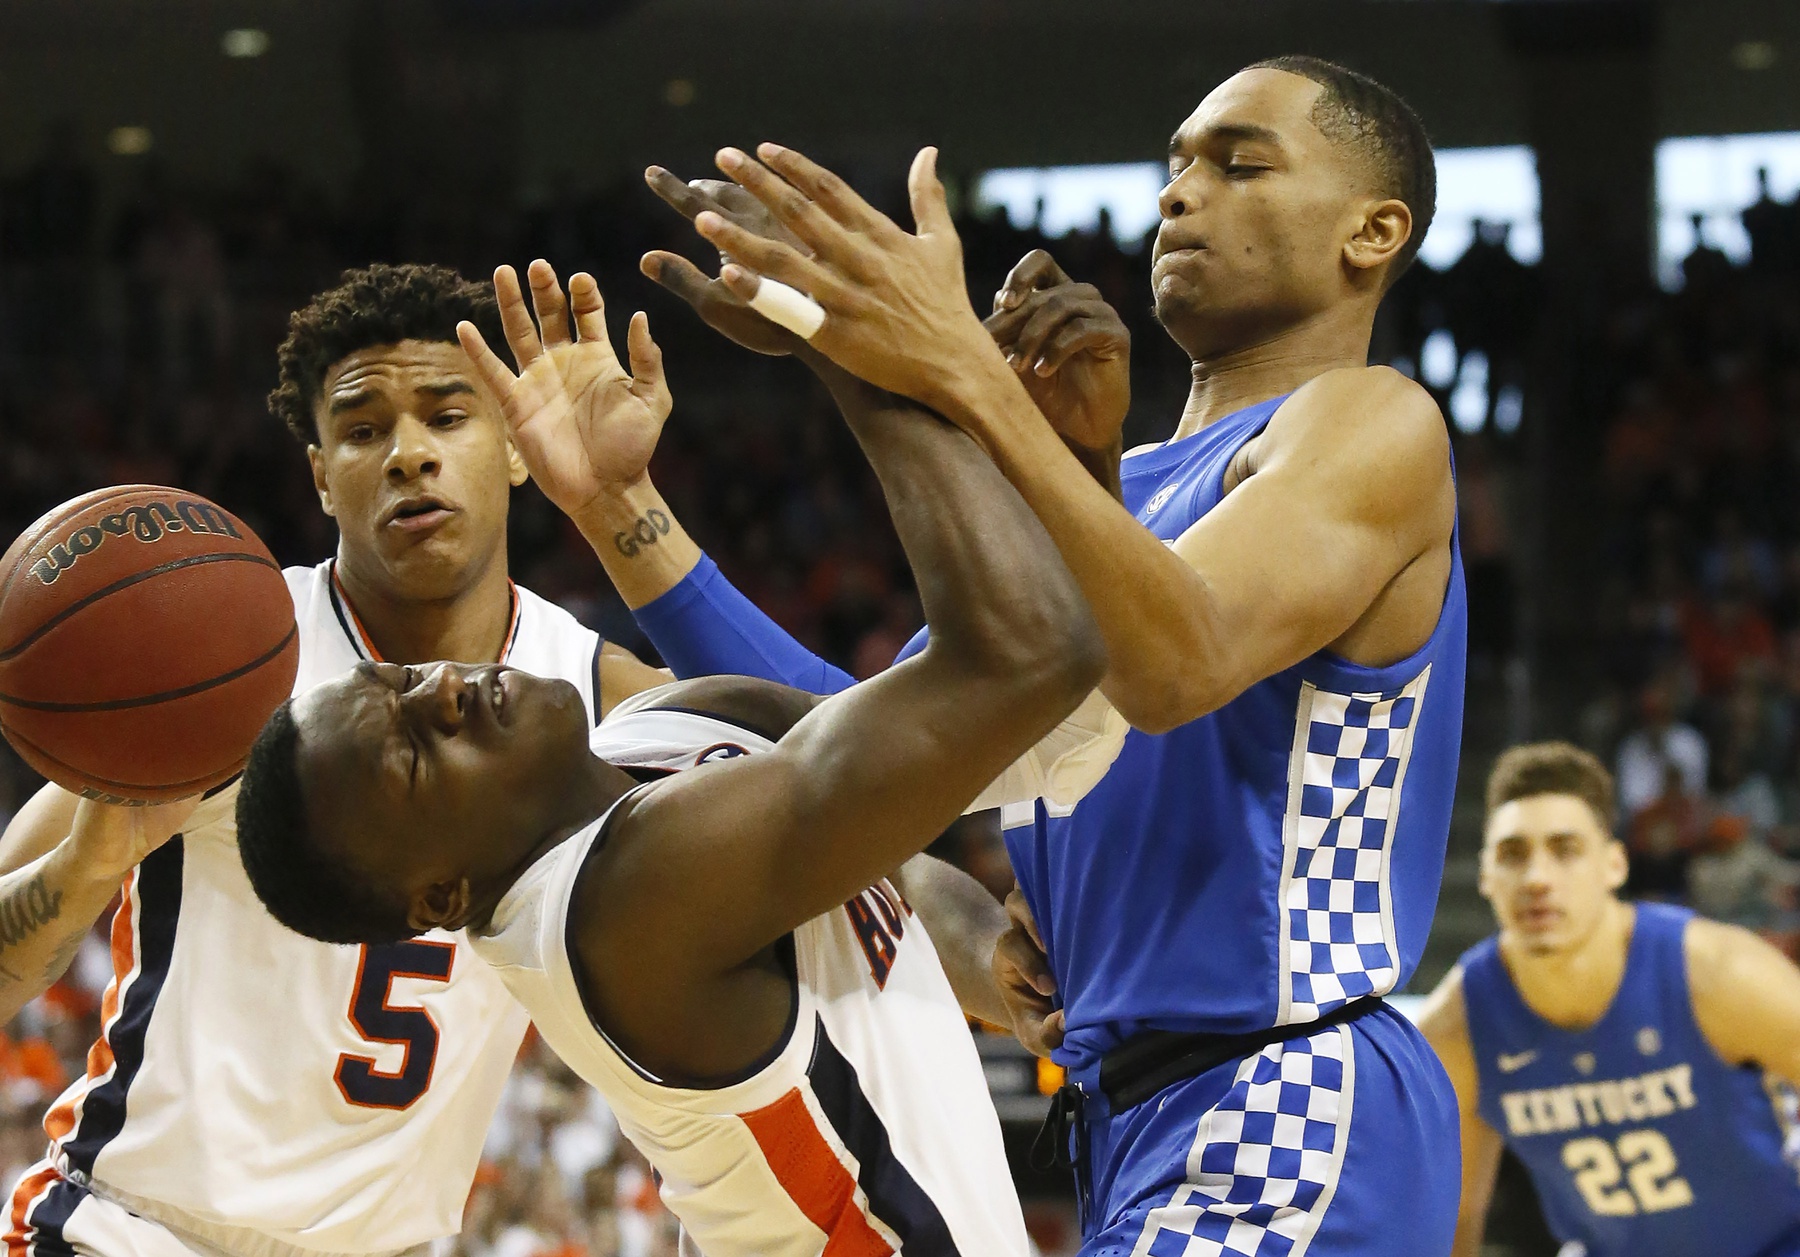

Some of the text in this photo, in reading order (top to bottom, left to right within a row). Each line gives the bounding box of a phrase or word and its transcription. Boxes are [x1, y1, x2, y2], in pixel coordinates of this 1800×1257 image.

[30, 501, 244, 586] Wilson
[613, 508, 670, 558] GOD
[333, 939, 457, 1112] 5
[1502, 1063, 1697, 1137] KENTUCKY
[1561, 1129, 1694, 1217] 22
